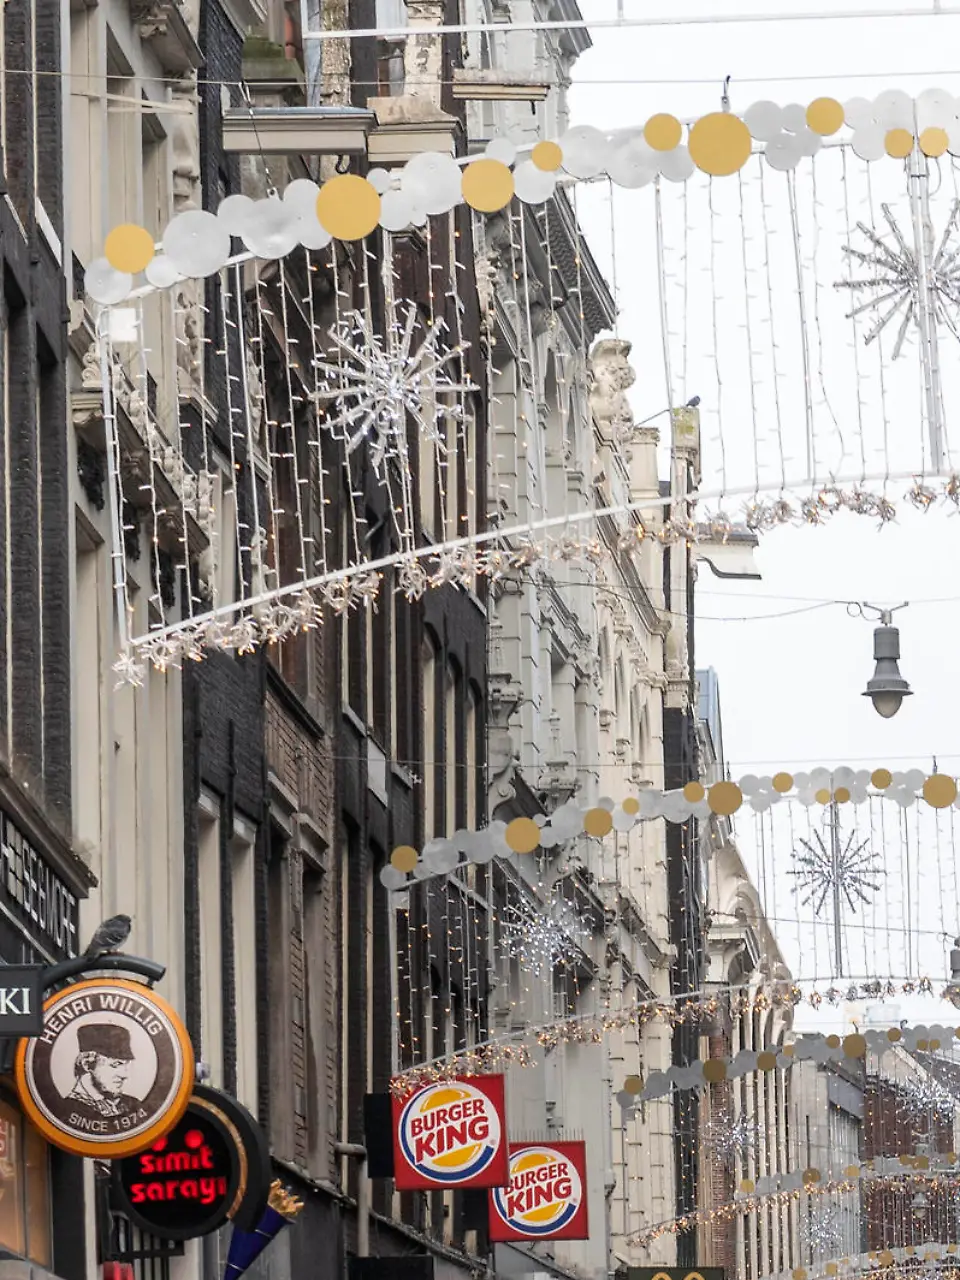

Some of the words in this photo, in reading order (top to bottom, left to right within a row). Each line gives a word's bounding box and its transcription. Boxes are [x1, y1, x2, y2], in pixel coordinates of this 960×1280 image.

[40, 998, 92, 1045] HENRI
[99, 994, 164, 1036] WILLIG
[68, 1112, 109, 1132] SINCE
[113, 1107, 148, 1131] 1974
[411, 1098, 486, 1138] BURGER
[415, 1115, 490, 1165] KING
[503, 1162, 569, 1196] BURGER
[506, 1177, 572, 1221] KING
